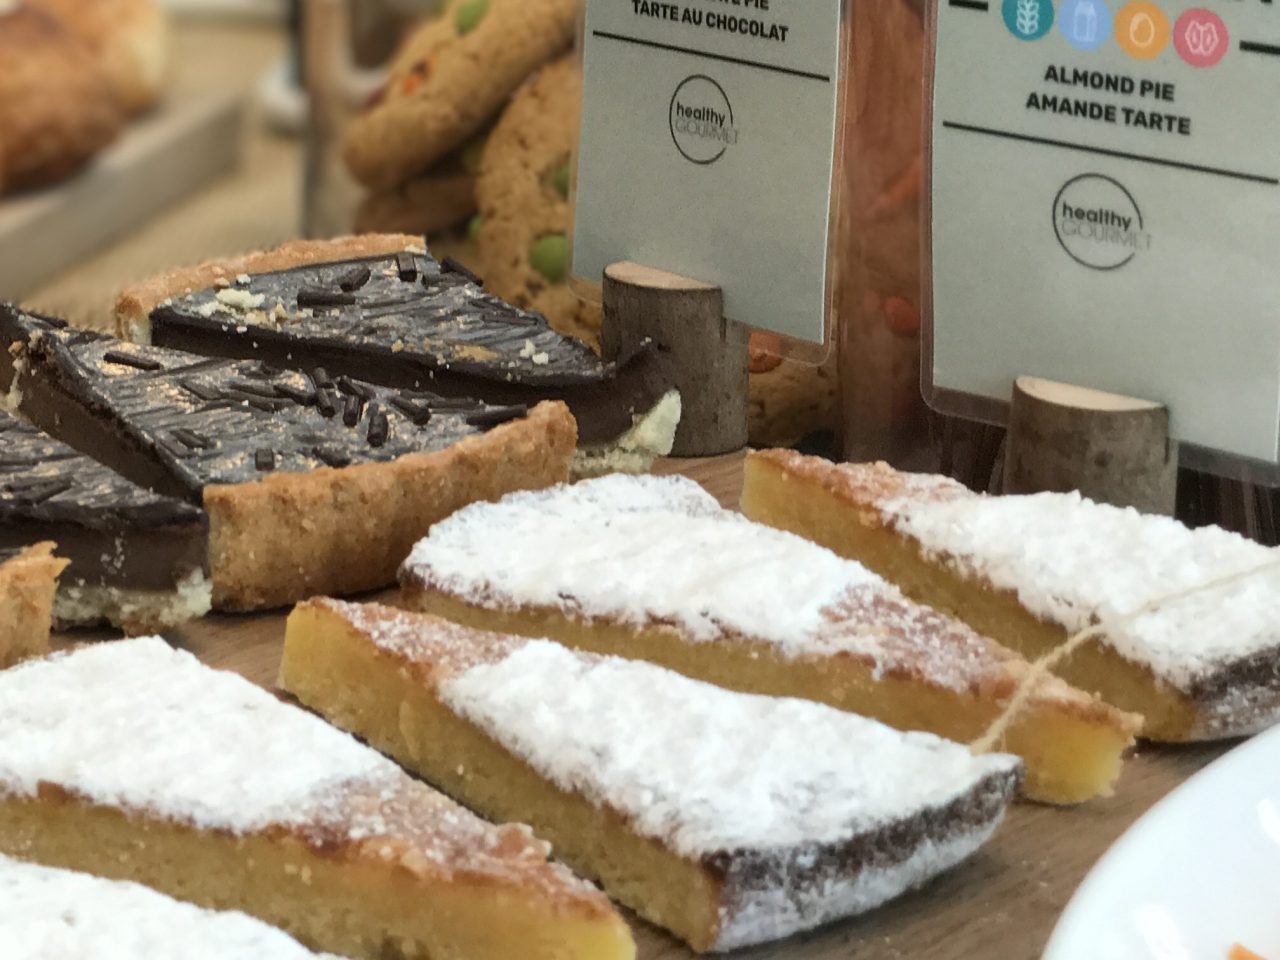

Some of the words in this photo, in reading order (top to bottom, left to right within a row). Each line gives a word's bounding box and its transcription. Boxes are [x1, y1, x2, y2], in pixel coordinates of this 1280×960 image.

[682, 7, 703, 26] AU
[706, 12, 788, 42] CHOCOLAT
[1044, 64, 1135, 95] ALMOND
[1139, 79, 1176, 102] PIE
[676, 101, 725, 127] healthy
[1026, 92, 1117, 123] AMANDE
[1121, 107, 1191, 135] TARTE
[1062, 201, 1132, 232] healthy
